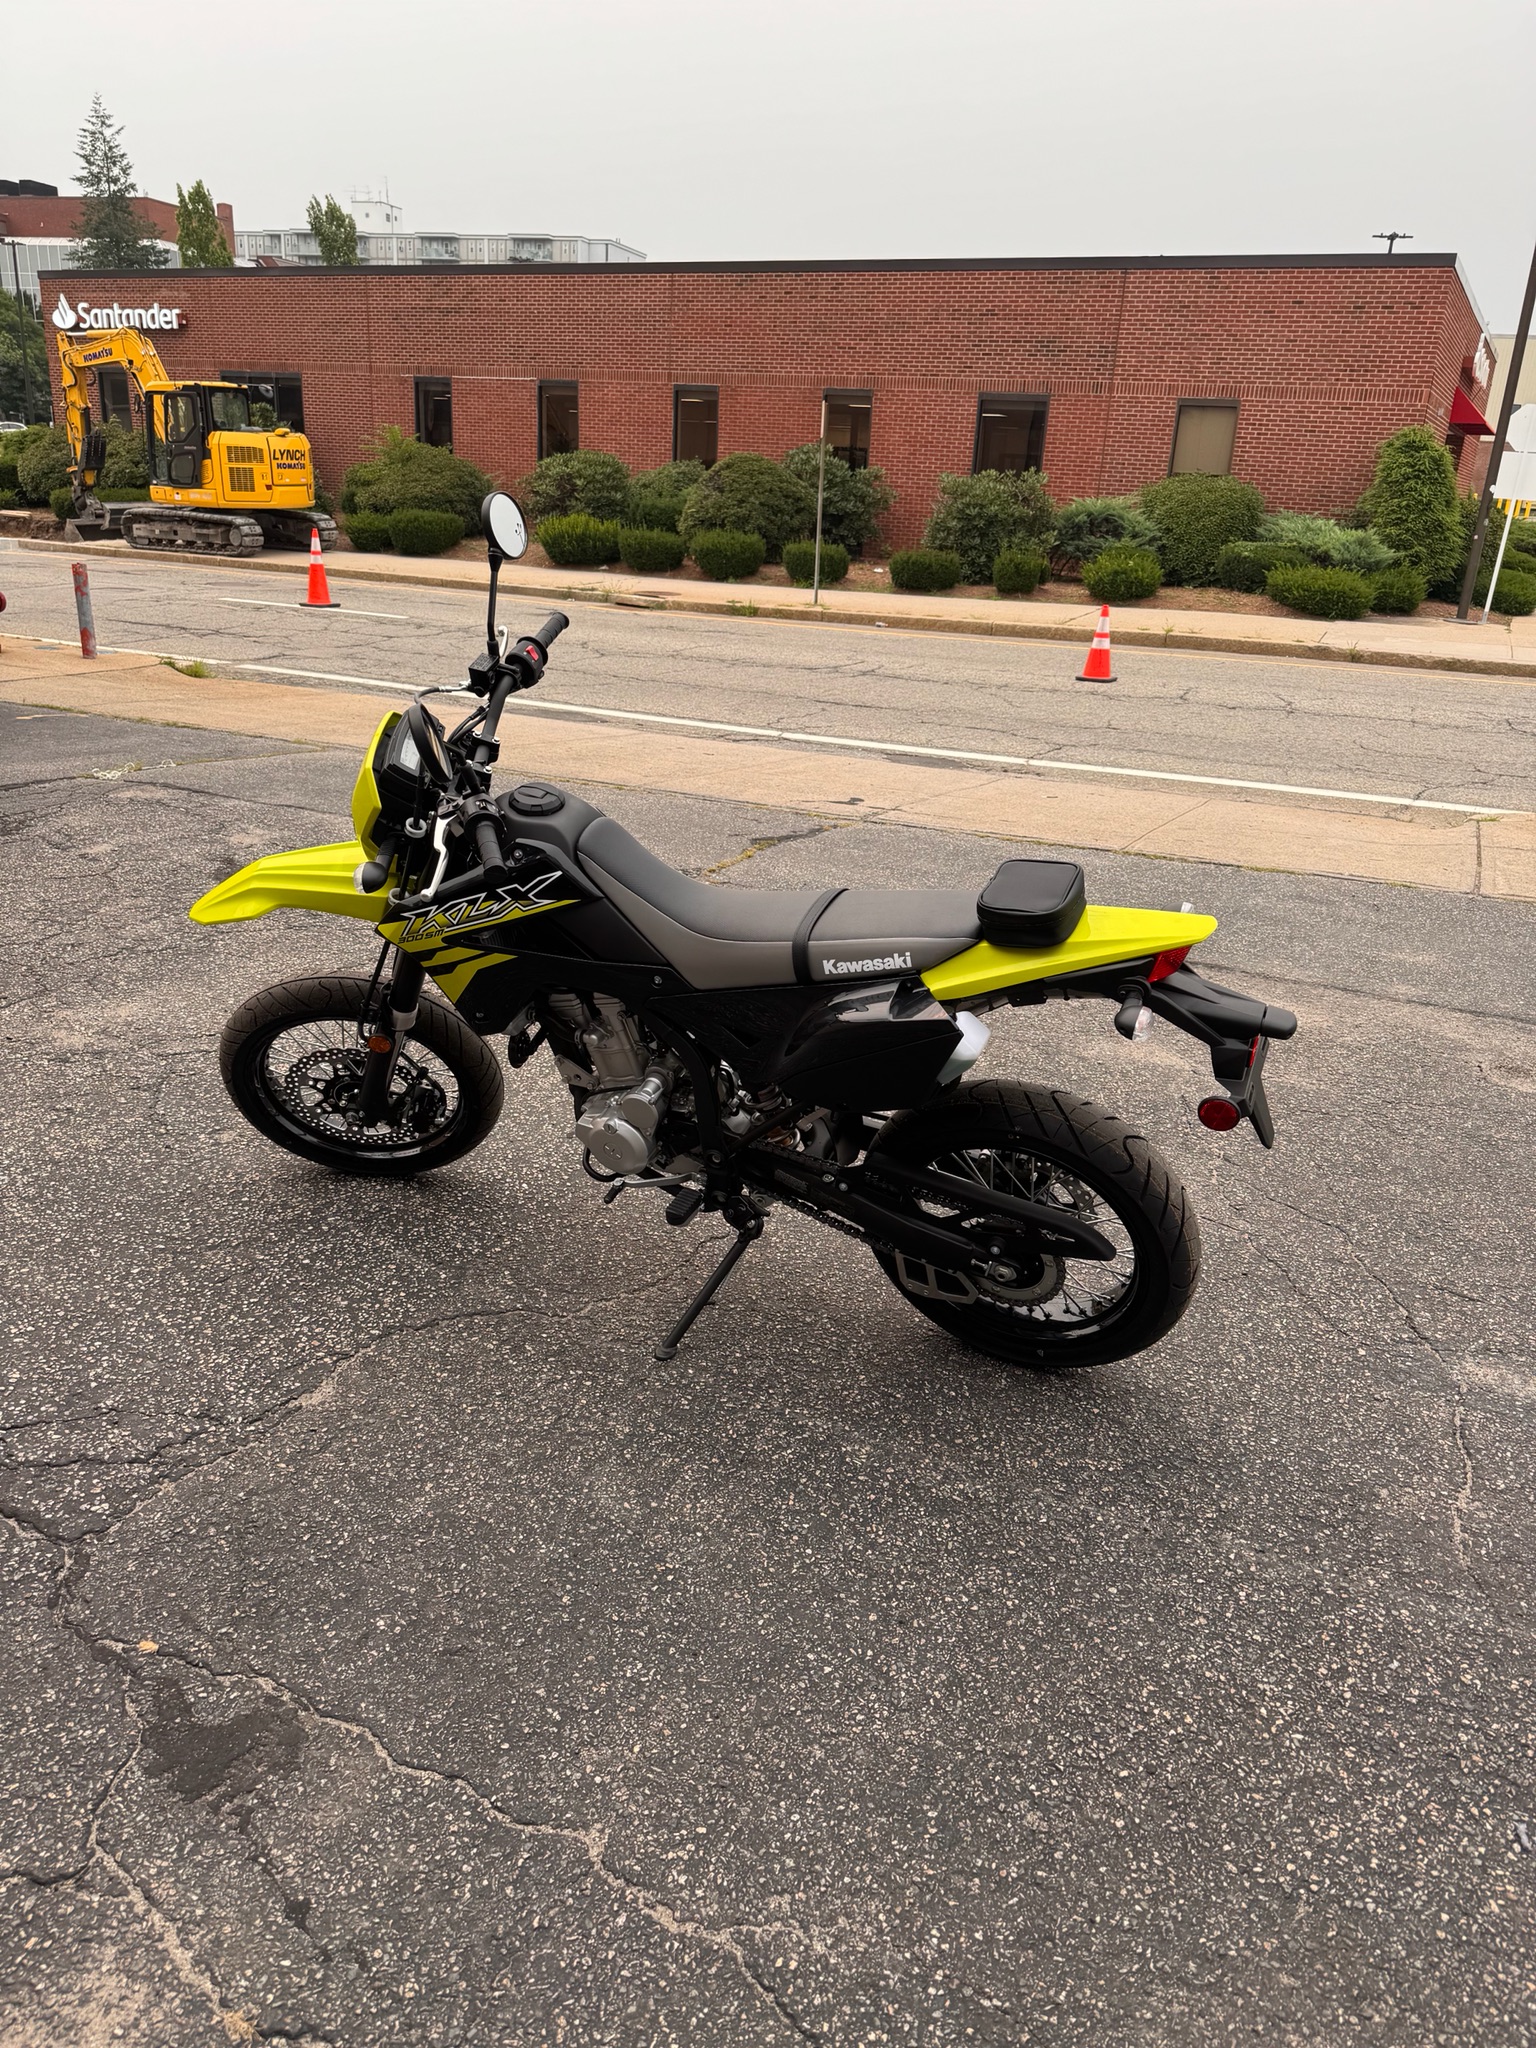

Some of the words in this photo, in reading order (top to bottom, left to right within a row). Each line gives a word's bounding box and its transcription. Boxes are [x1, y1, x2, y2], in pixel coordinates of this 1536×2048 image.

[77, 302, 181, 329] Santander
[83, 347, 113, 363] KOMATSU
[272, 448, 306, 461] LYNCH
[276, 461, 306, 470] KOMATSU
[400, 871, 563, 936] KLX
[822, 952, 913, 975] Kawasaki
